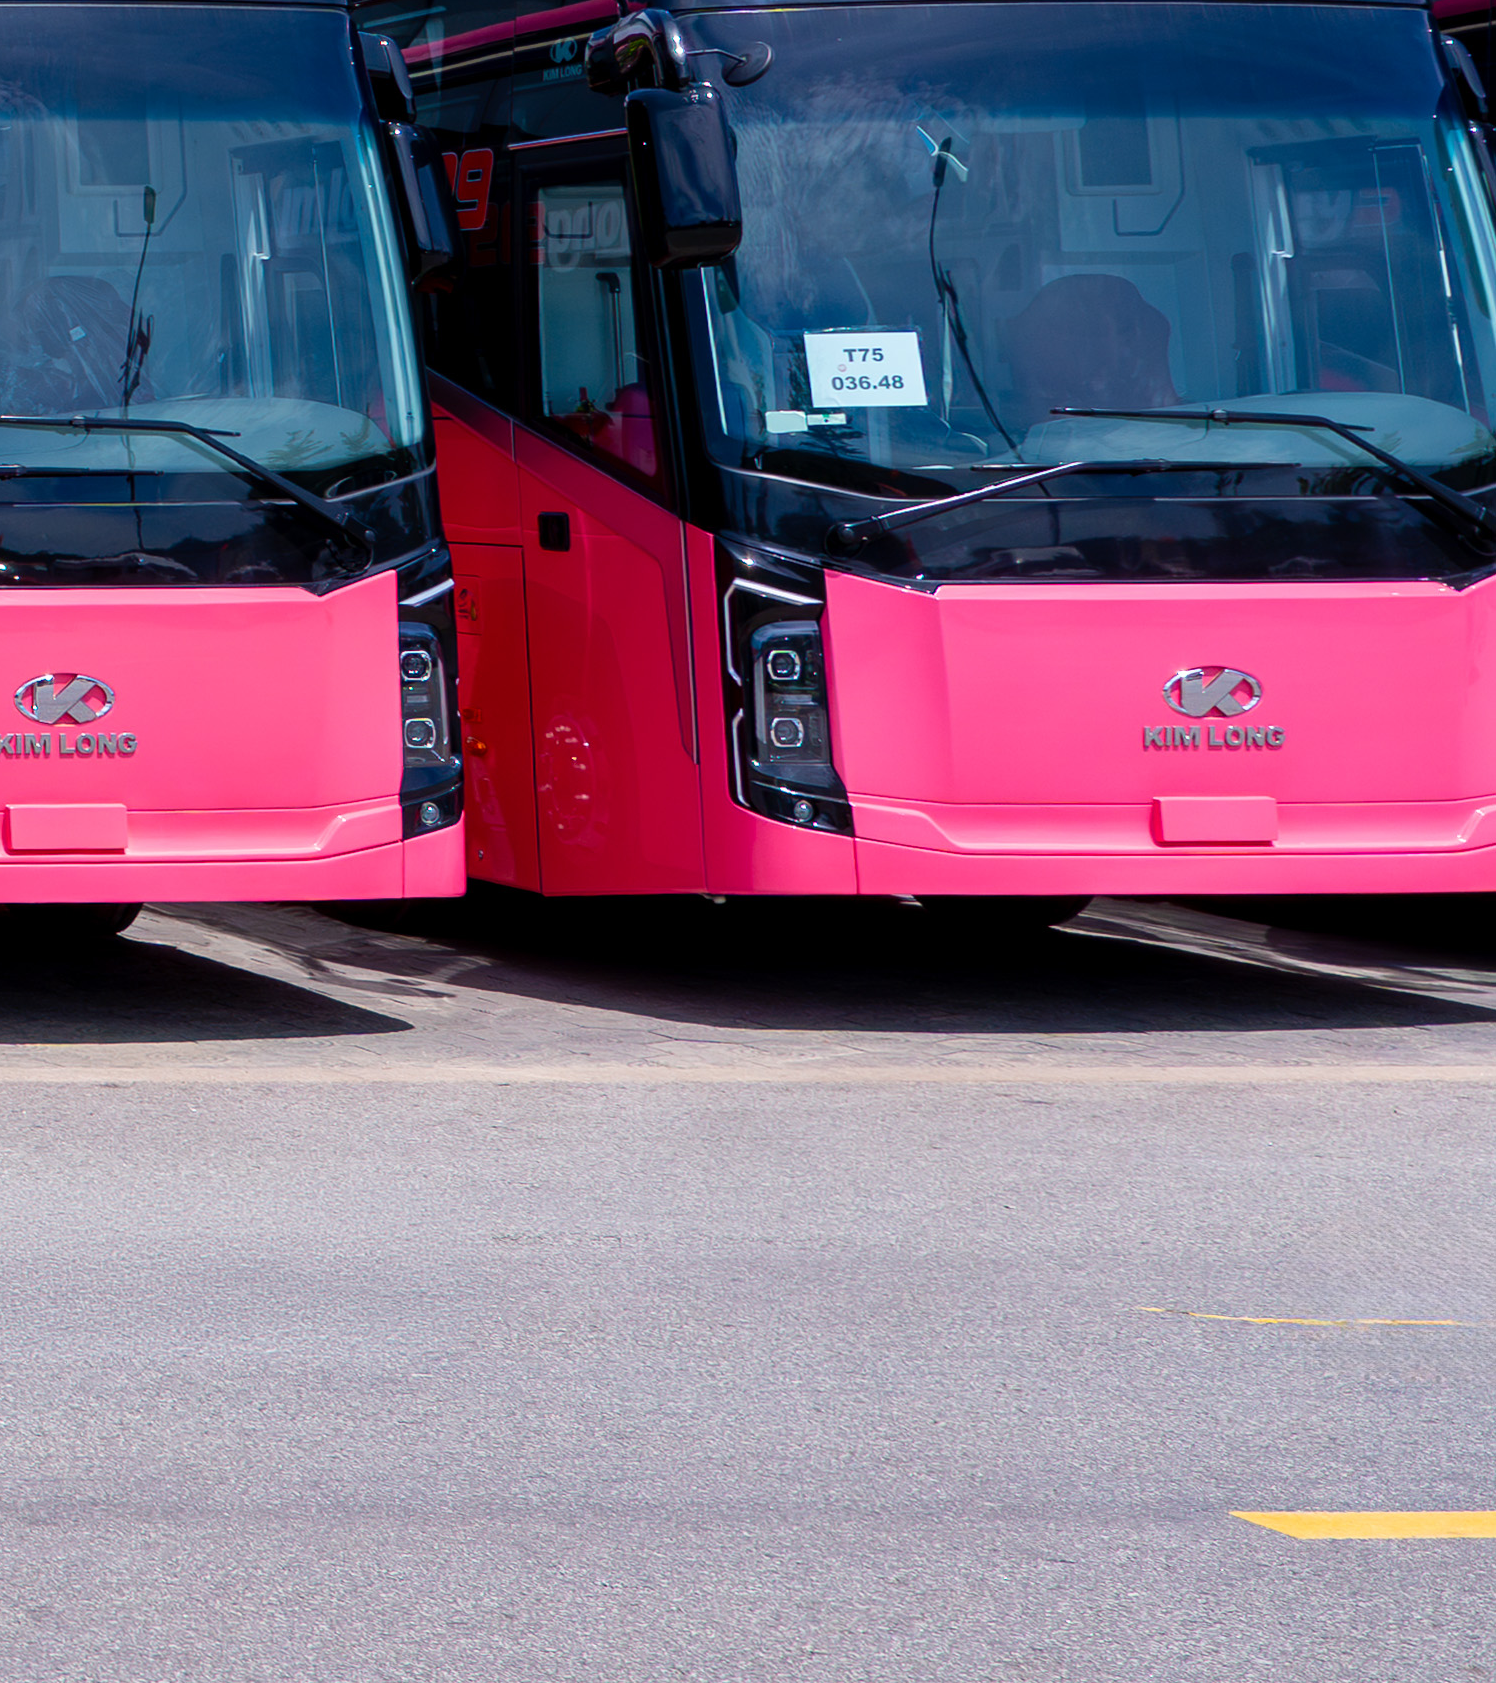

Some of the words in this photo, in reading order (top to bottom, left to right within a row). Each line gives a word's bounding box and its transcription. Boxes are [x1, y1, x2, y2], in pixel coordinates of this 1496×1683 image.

[560, 65, 582, 78] LONG
[843, 348, 884, 362] T75
[831, 375, 904, 390] 036.48
[59, 732, 138, 755] LONG
[1143, 726, 1201, 747] KIM
[1208, 725, 1286, 747] LONG
